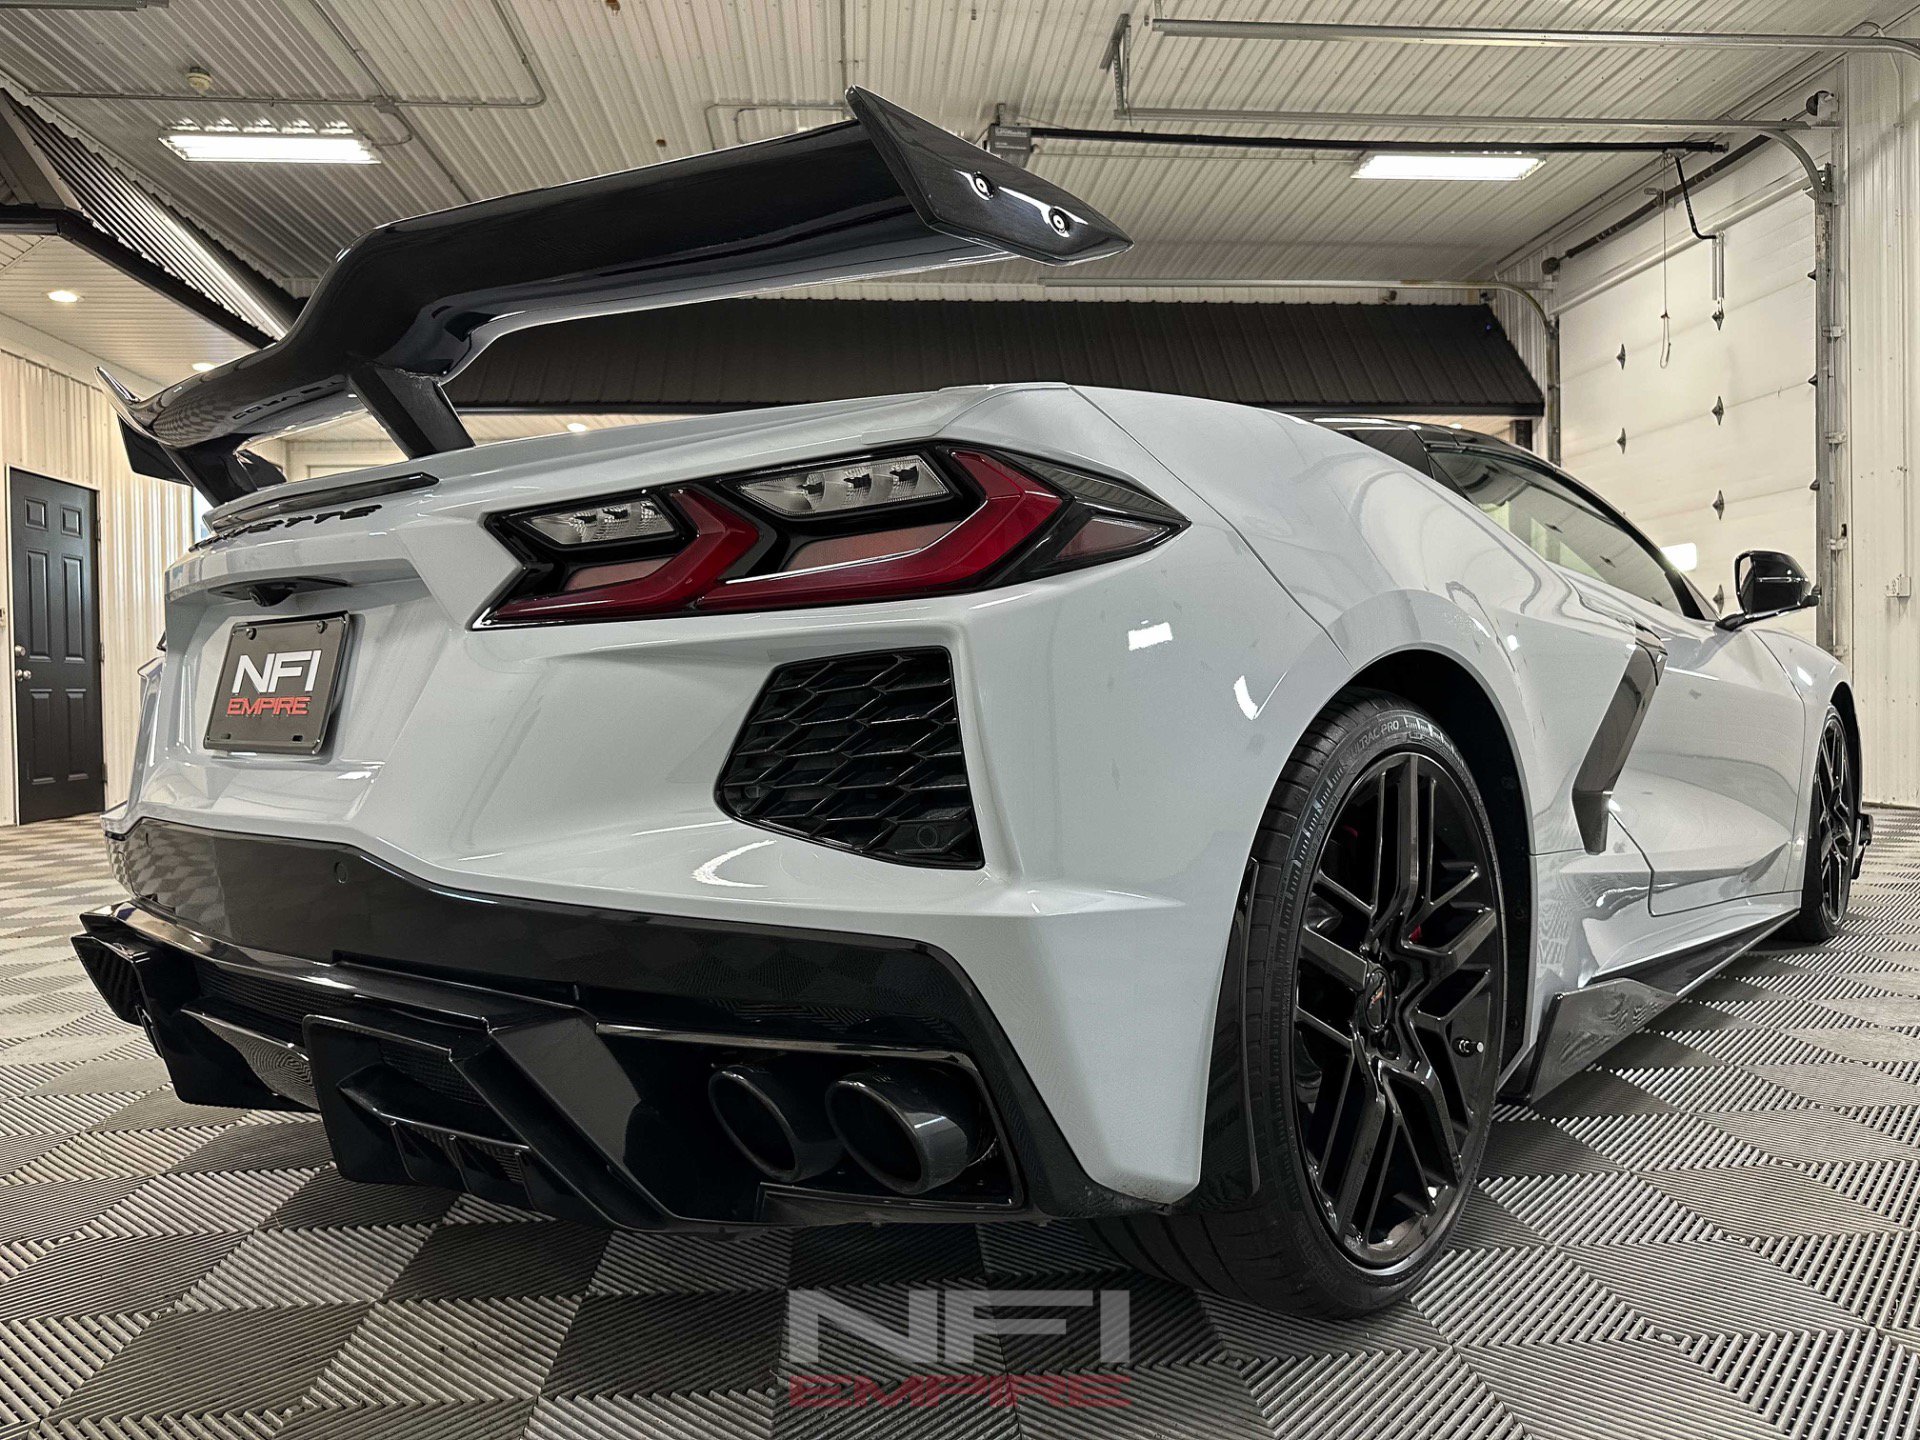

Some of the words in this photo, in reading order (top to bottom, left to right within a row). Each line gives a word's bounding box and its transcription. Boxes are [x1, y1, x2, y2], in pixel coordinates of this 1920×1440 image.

[231, 650, 322, 694] NFI
[226, 696, 312, 716] EMPIRE
[1381, 720, 1399, 735] PRO
